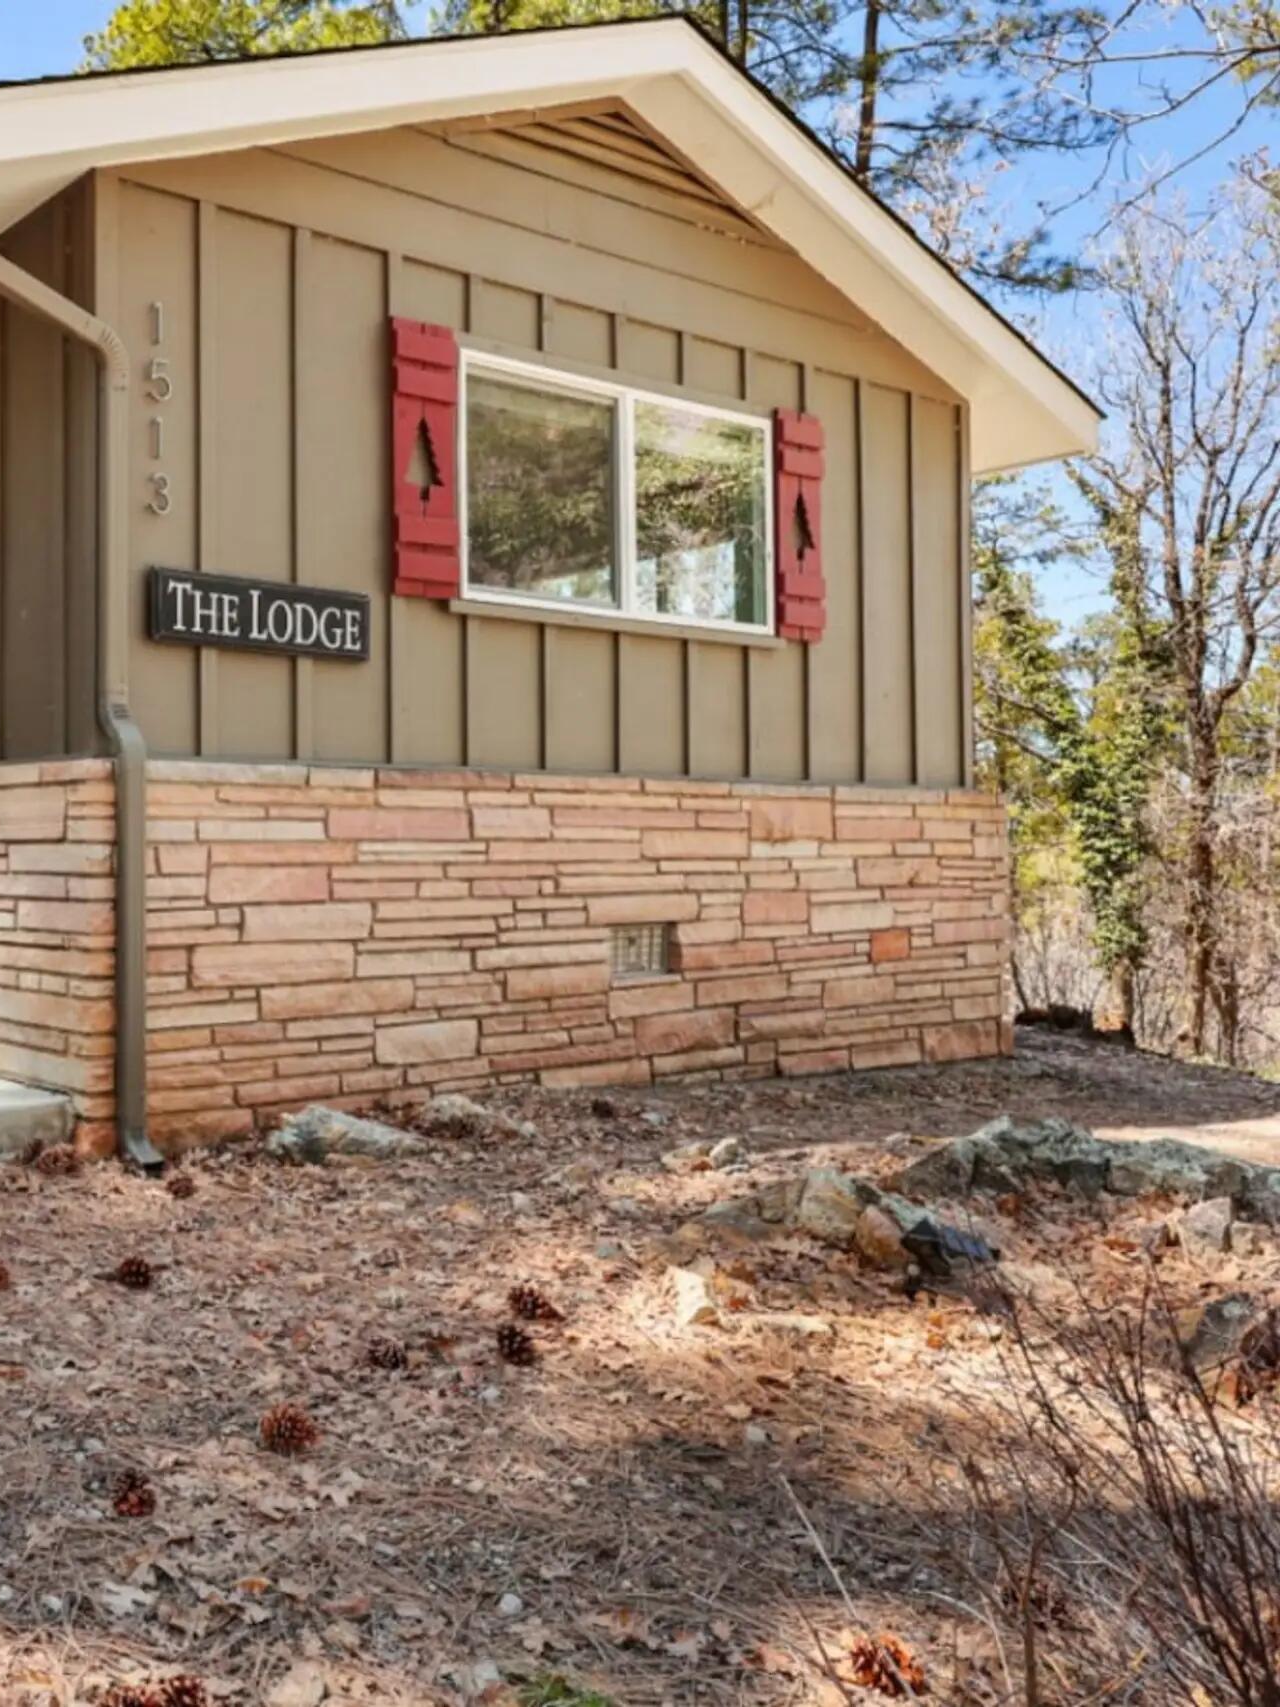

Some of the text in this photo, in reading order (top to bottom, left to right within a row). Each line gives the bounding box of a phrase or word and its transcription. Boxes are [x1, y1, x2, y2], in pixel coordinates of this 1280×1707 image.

[147, 301, 172, 515] 1513
[167, 579, 363, 651] THE LODGE
